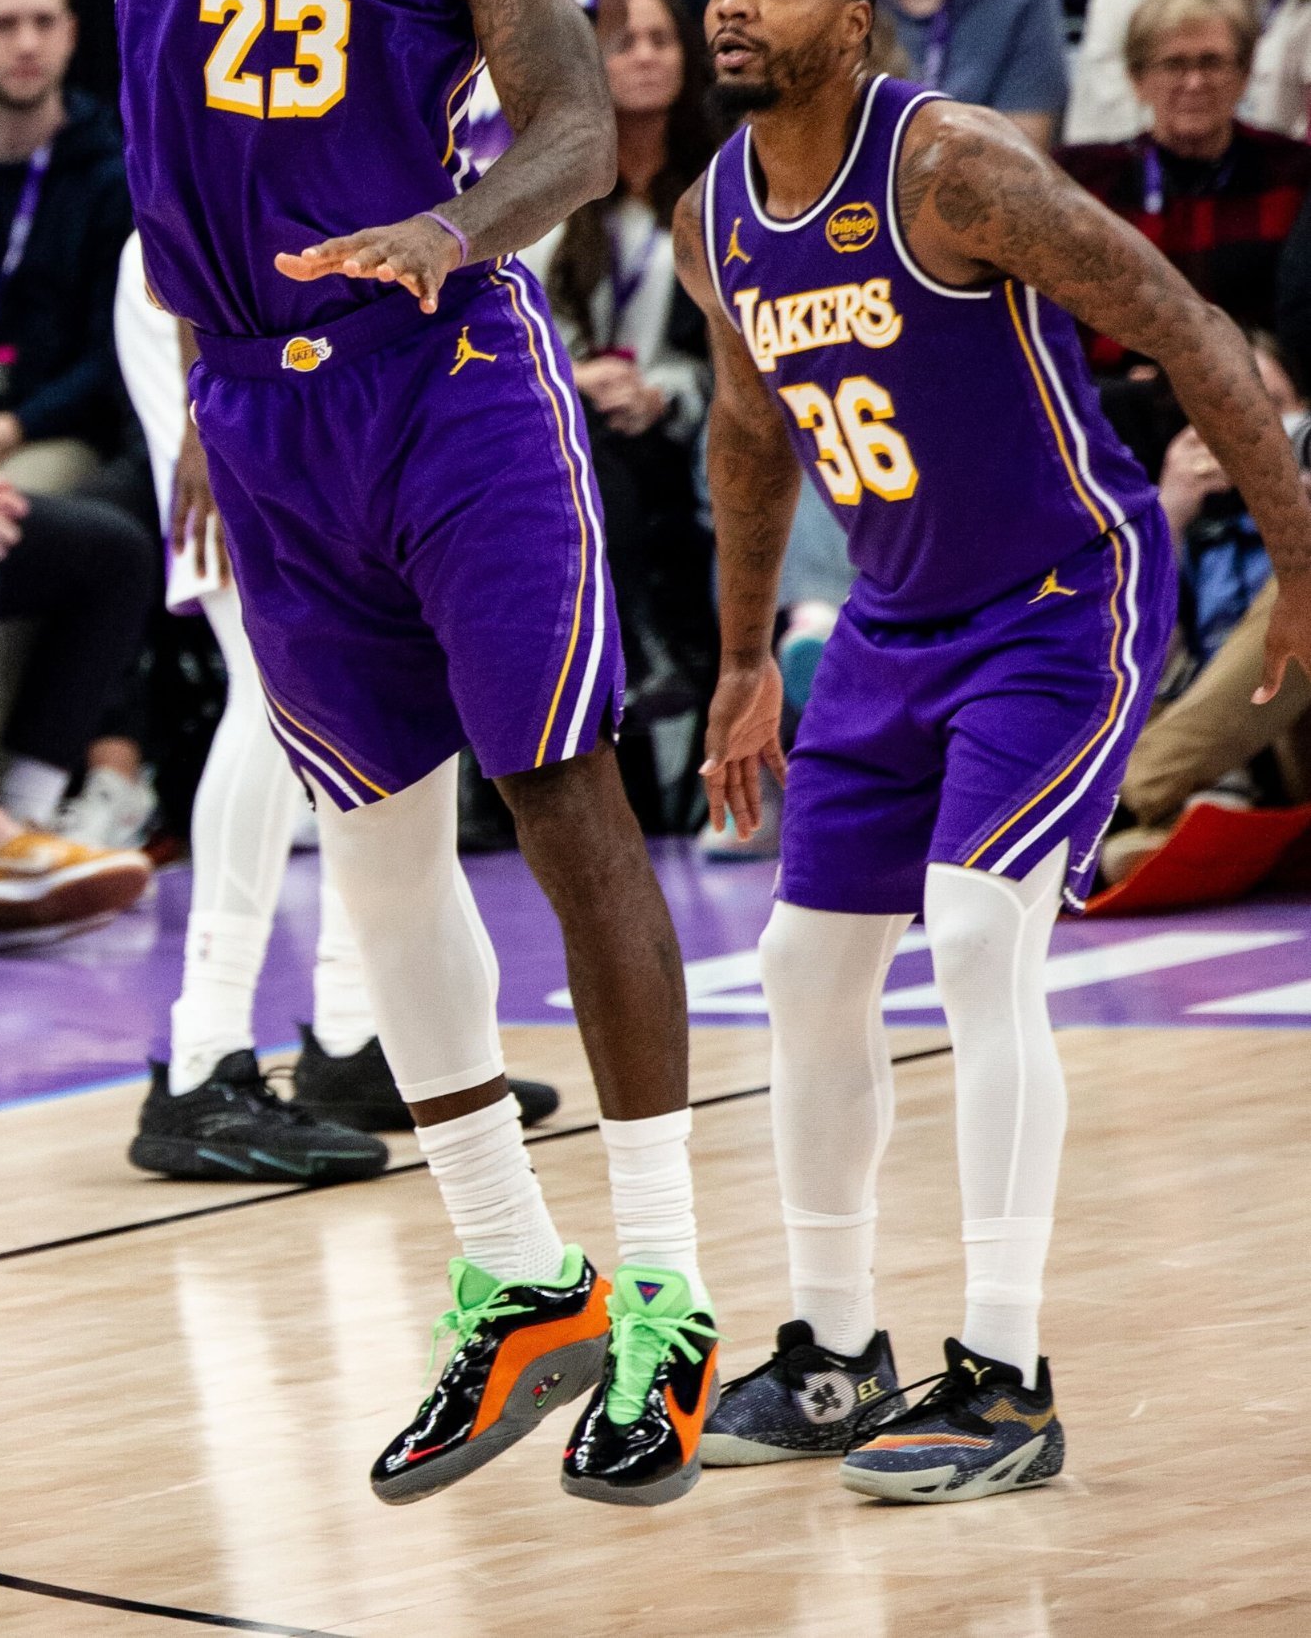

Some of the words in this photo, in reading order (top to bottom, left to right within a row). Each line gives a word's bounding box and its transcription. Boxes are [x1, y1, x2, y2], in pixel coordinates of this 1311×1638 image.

[831, 214, 877, 236] bibigo
[734, 278, 904, 373] LAKERS
[283, 344, 331, 368] LAKERS
[777, 375, 919, 505] 36
